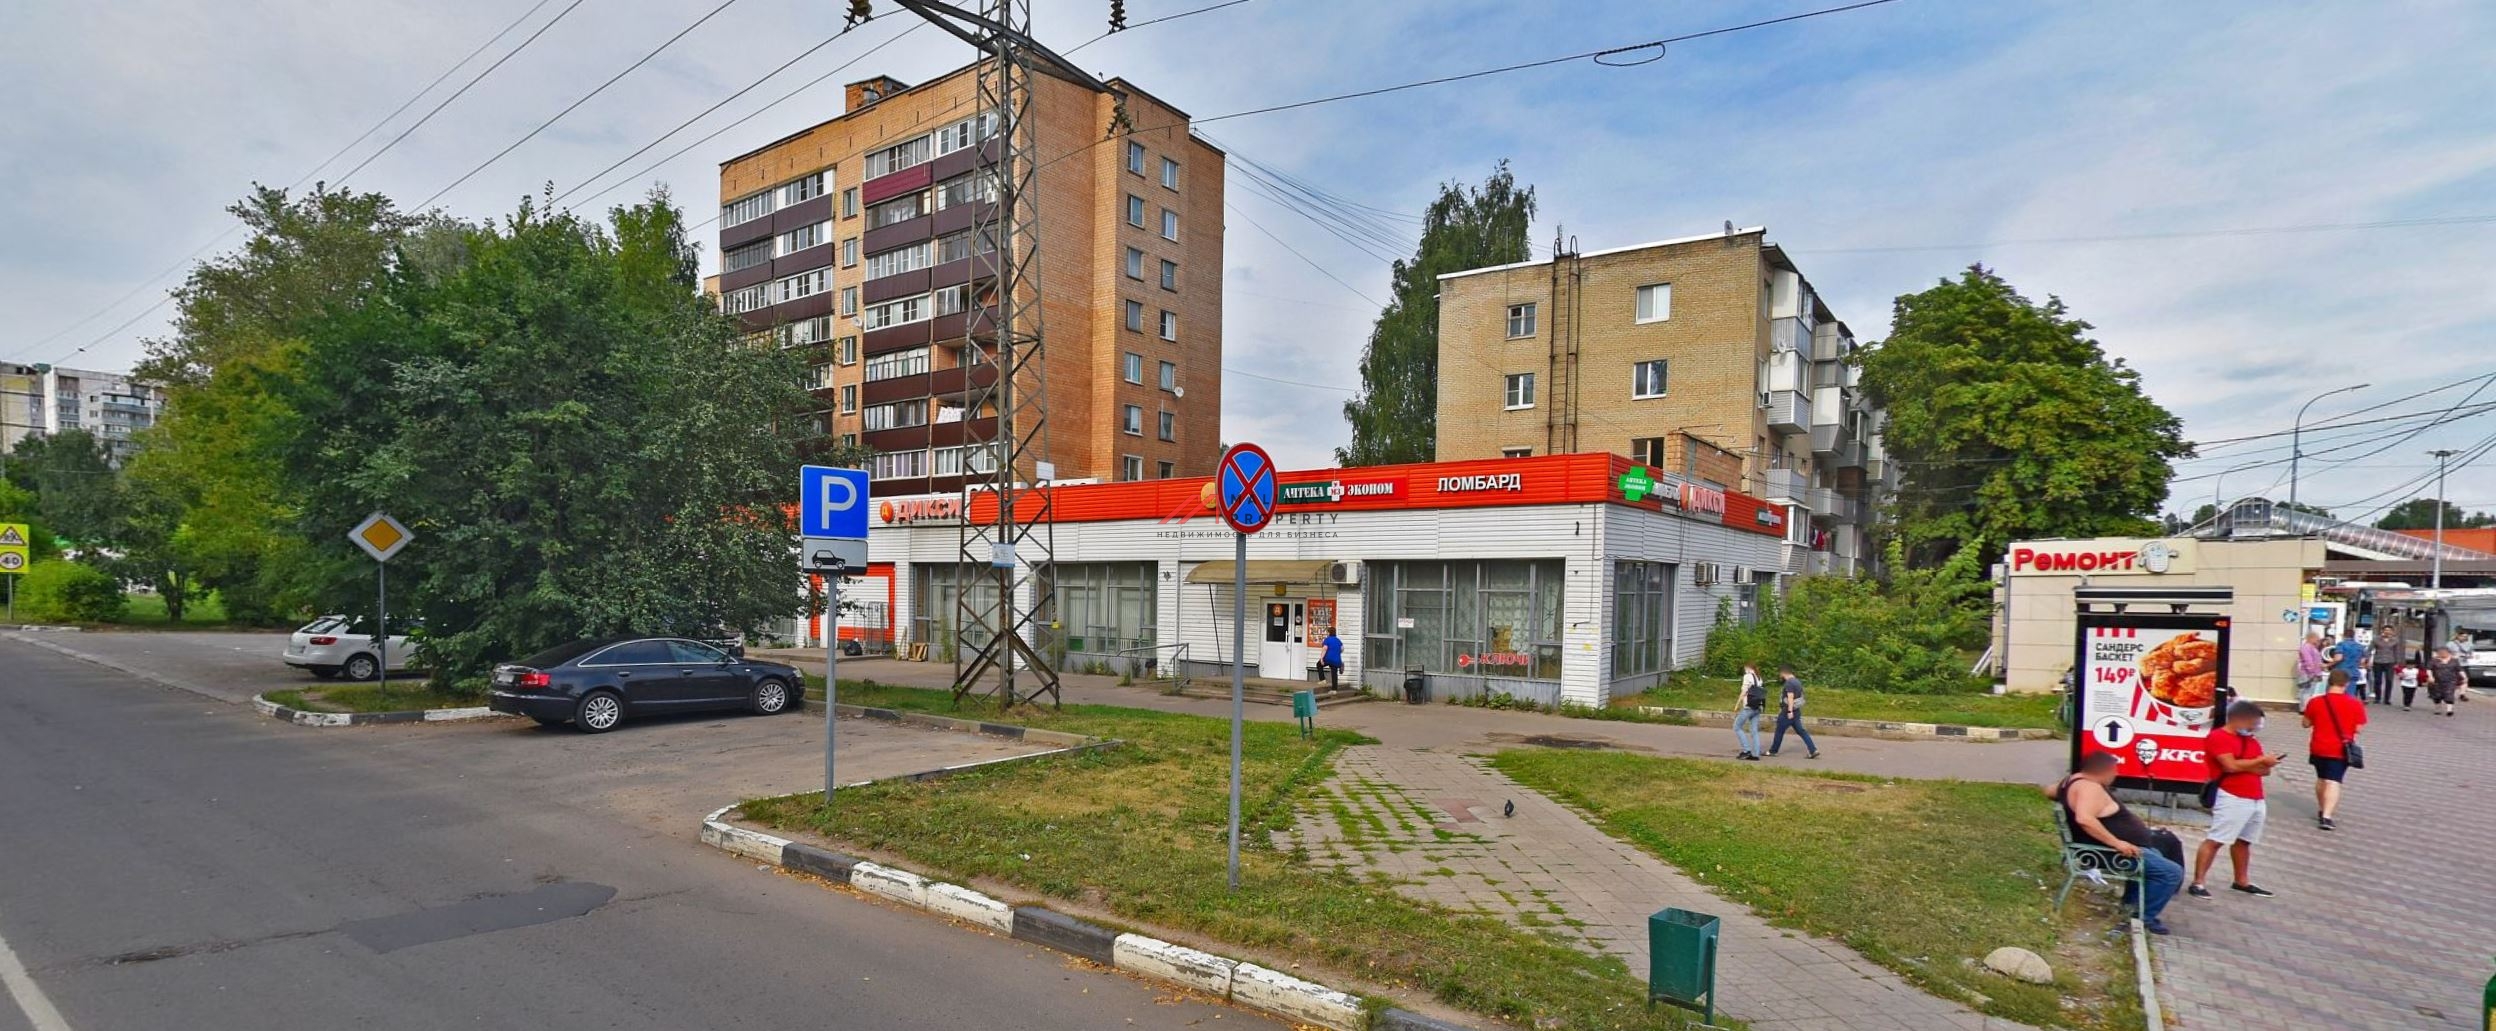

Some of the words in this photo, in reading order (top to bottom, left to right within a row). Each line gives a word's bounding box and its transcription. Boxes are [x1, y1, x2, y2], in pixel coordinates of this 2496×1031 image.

[1283, 486, 1324, 499] АПТЕКА
[1347, 482, 1393, 496] ЭКОНОМ
[1436, 473, 1521, 492] ЛОМБАРД
[821, 475, 857, 530] P
[896, 498, 962, 524] ДИКСИ
[2014, 548, 2138, 571] Ремонт
[2095, 642, 2144, 653] САНДЕРС
[1480, 652, 1534, 665] КЛЮЧИ
[2095, 652, 2133, 661] БАСКЕТ
[2159, 748, 2206, 764] KFC
